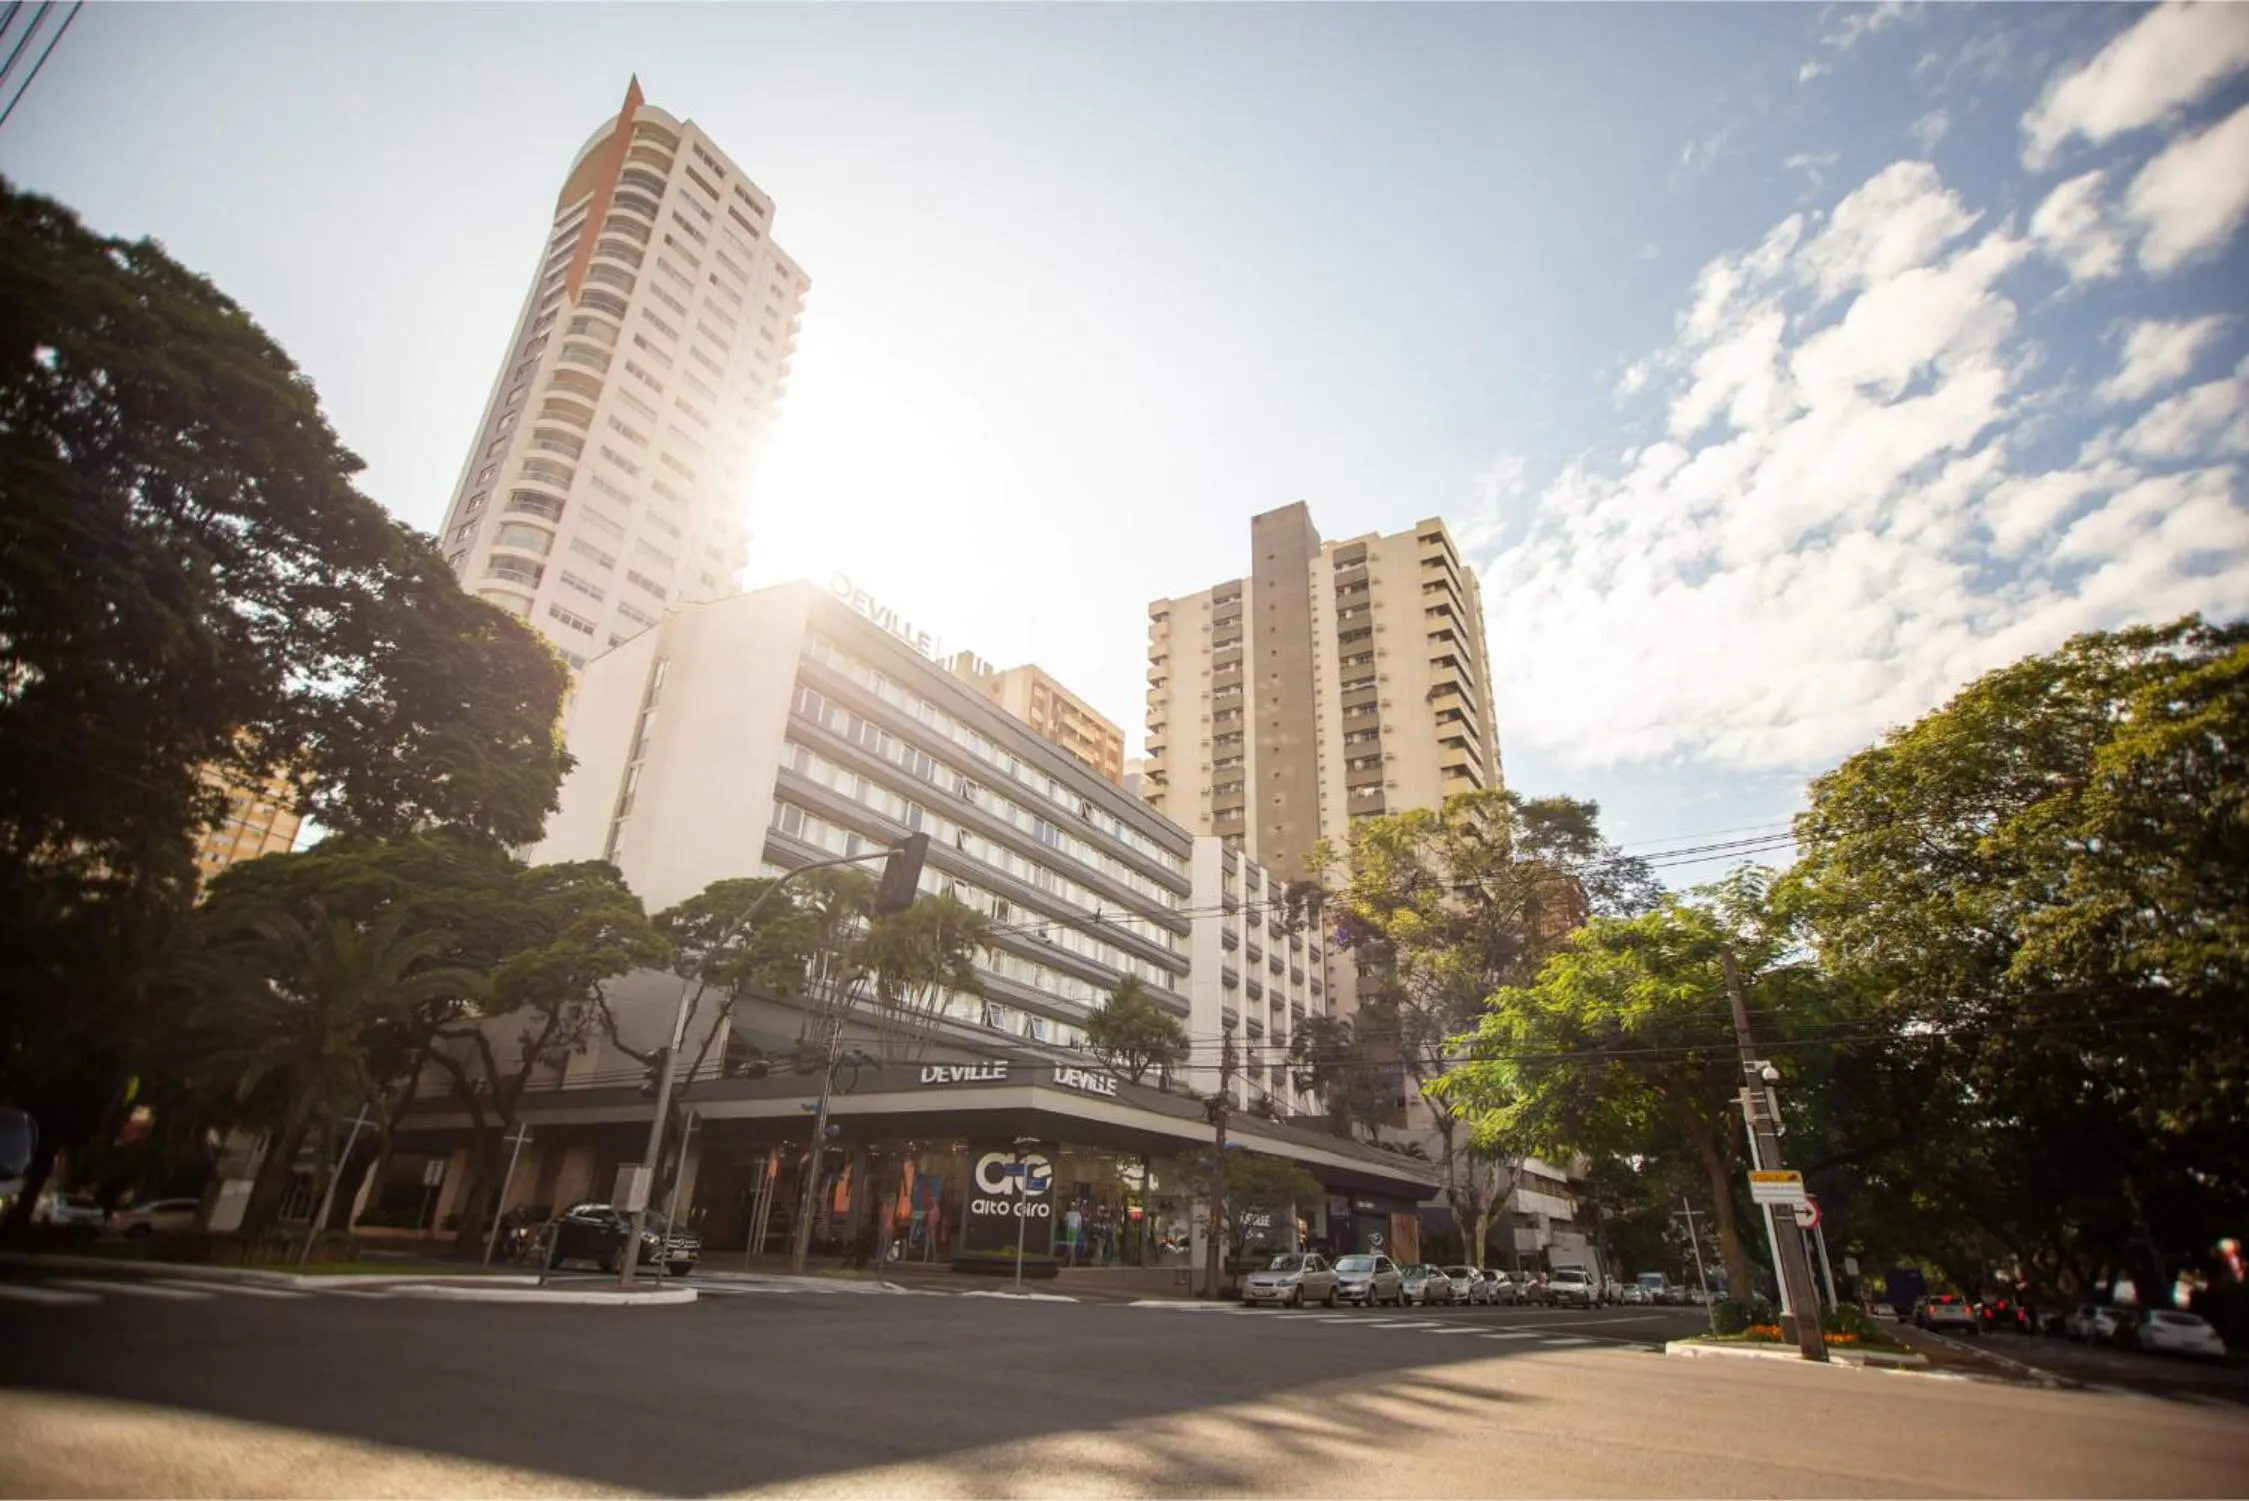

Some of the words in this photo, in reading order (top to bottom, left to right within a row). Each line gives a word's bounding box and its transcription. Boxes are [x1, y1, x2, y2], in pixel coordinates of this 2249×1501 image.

[830, 570, 931, 656] DEVILLE
[921, 1060, 1008, 1084] DEVILLE
[1054, 1061, 1117, 1096] DEVILLE
